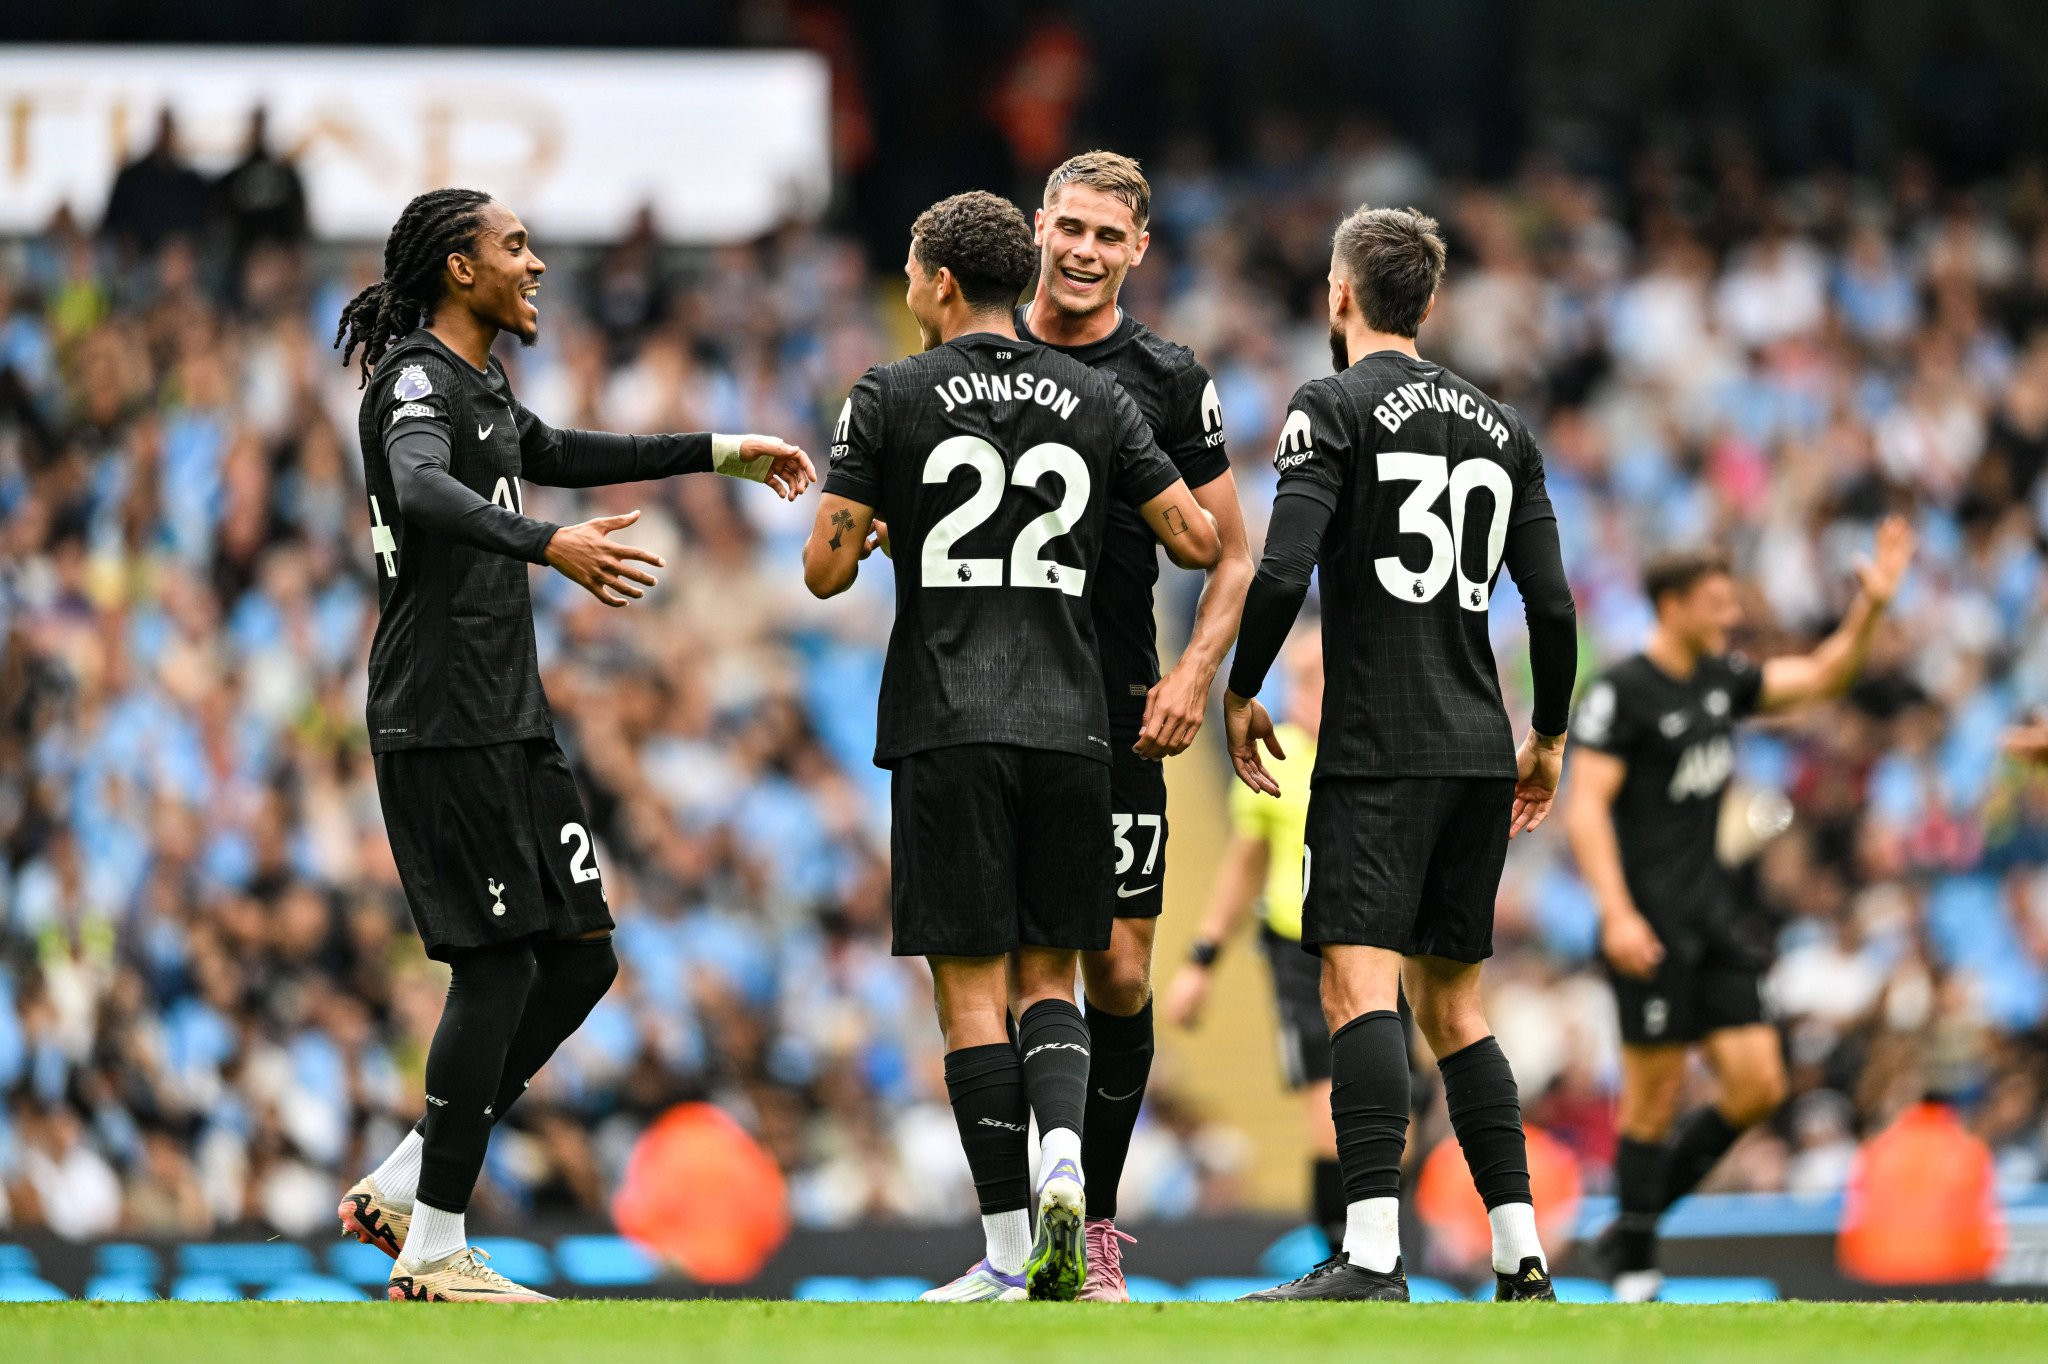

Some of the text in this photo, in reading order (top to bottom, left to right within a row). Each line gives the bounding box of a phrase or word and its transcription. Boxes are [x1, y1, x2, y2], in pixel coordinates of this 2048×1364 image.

[934, 372, 1081, 421] JOHNSON
[1373, 382, 1510, 450] BENTANCUR
[1278, 450, 1314, 471] aken
[921, 435, 1091, 597] 22
[1374, 451, 1513, 612] 30
[560, 822, 600, 884] 2
[1111, 813, 1162, 875] 37
